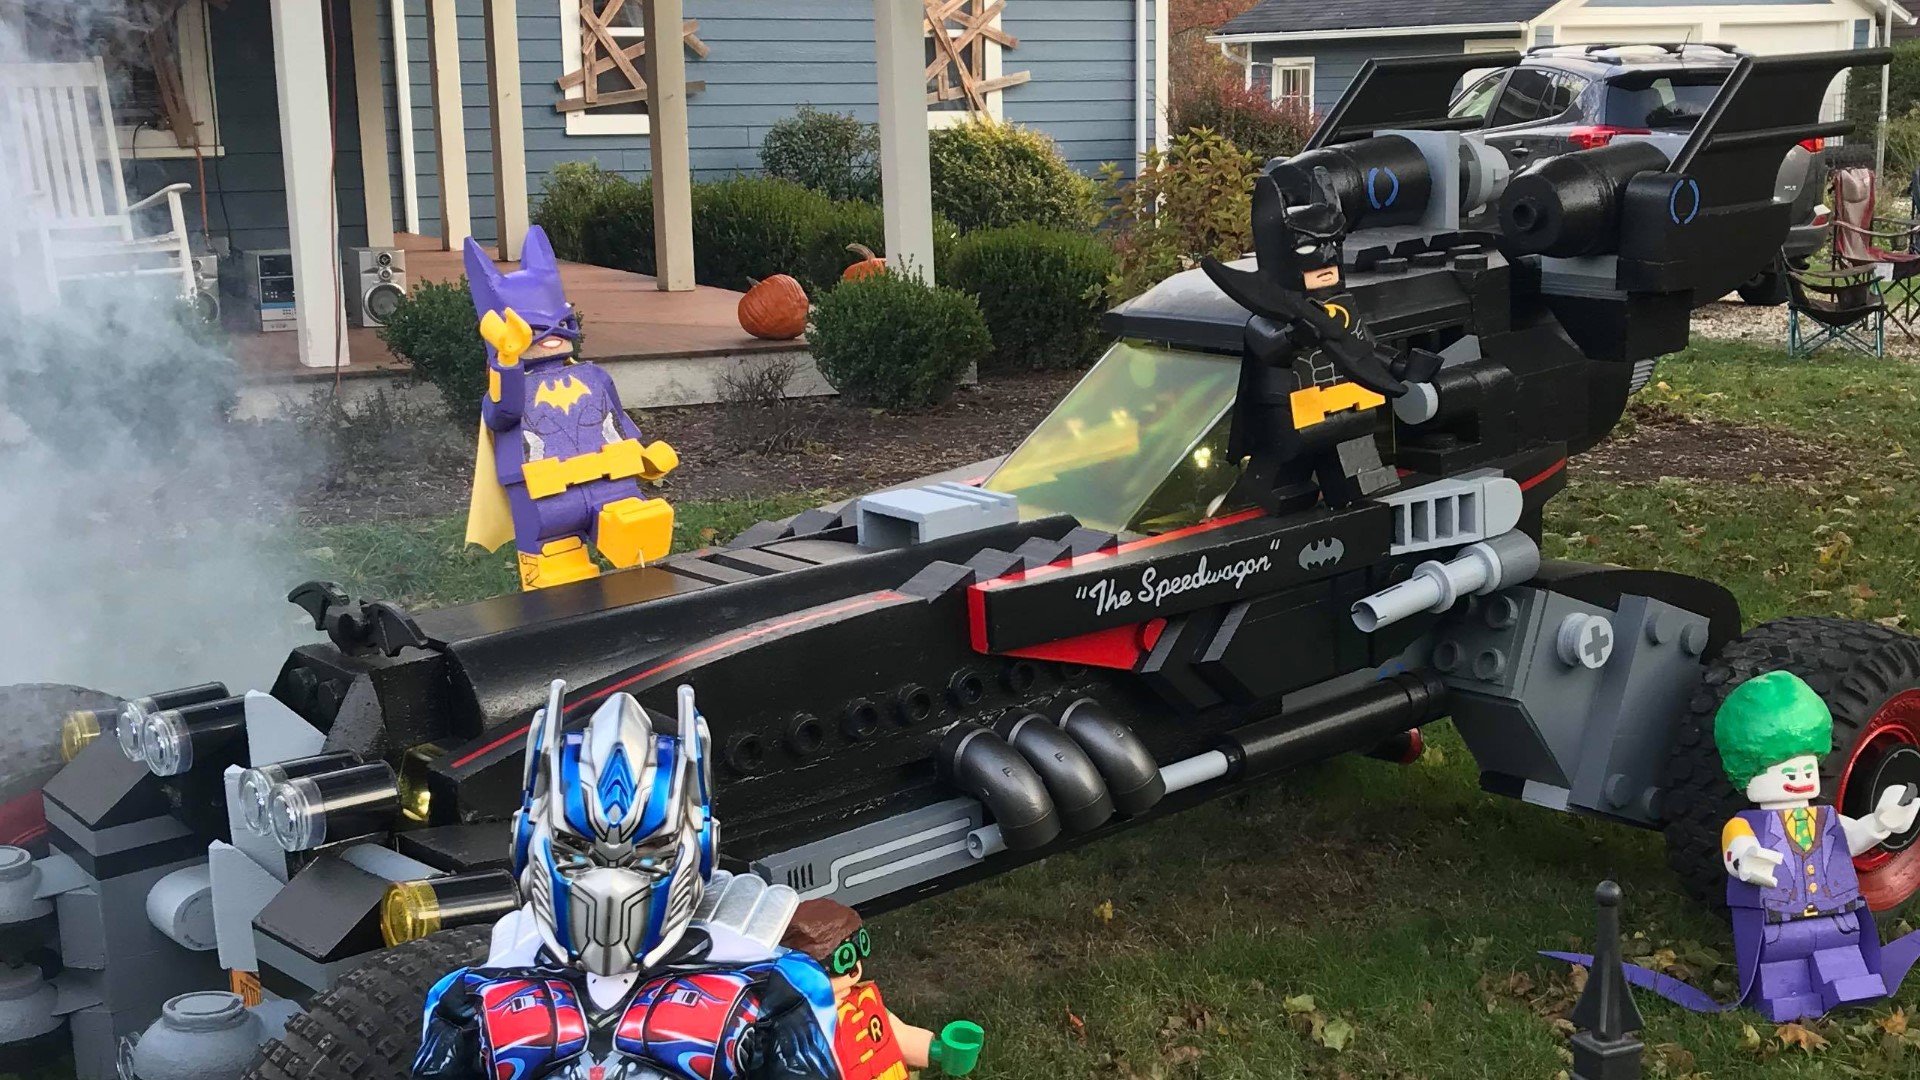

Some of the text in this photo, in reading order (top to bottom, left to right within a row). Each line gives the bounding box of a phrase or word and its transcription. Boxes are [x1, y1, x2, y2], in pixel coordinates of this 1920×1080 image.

[1075, 538, 1281, 616] "The Speedwagon"
[870, 1016, 882, 1042] R
